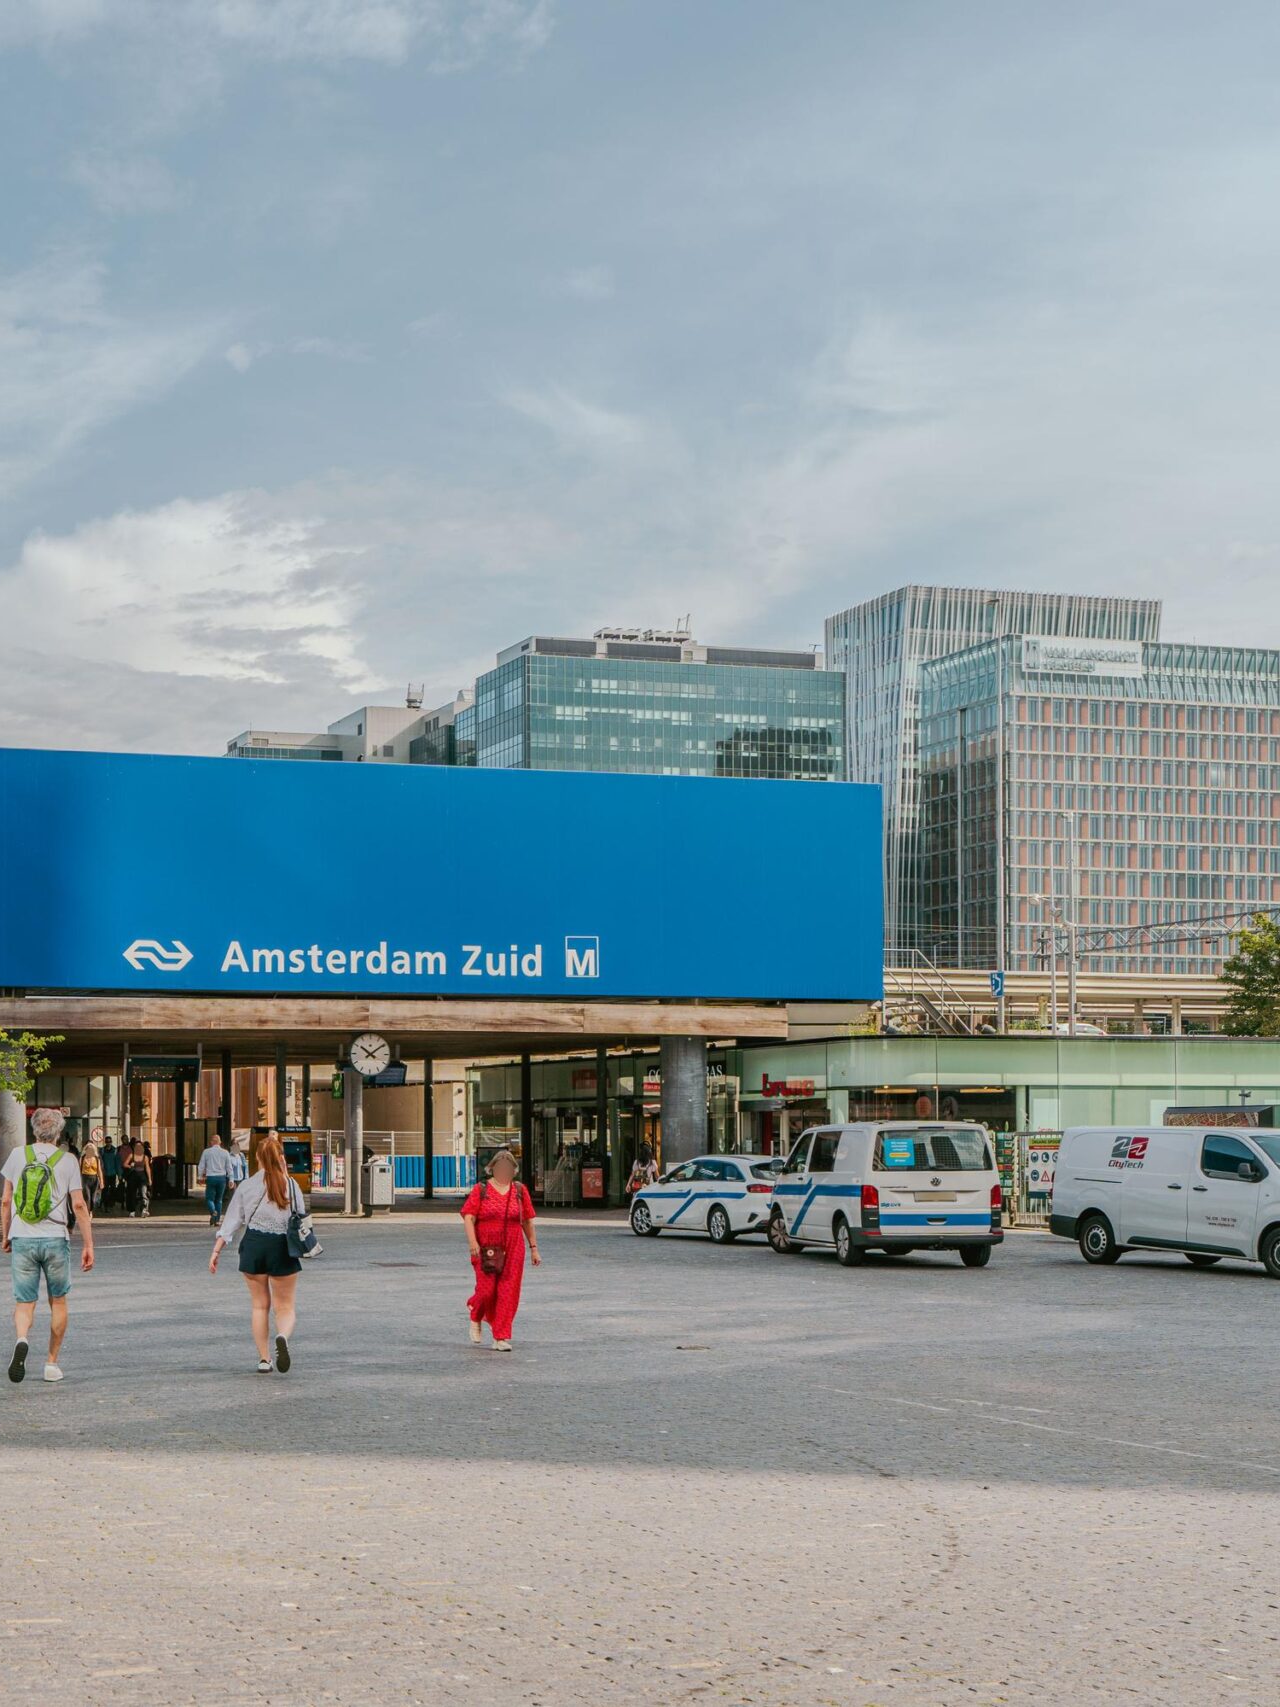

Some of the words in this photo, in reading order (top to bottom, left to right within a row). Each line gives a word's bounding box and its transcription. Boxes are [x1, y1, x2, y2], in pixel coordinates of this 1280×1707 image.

[221, 940, 447, 976] Amsterdam
[461, 944, 543, 977] Zuid
[566, 947, 599, 977] M
[1108, 1159, 1144, 1170] CityTech
